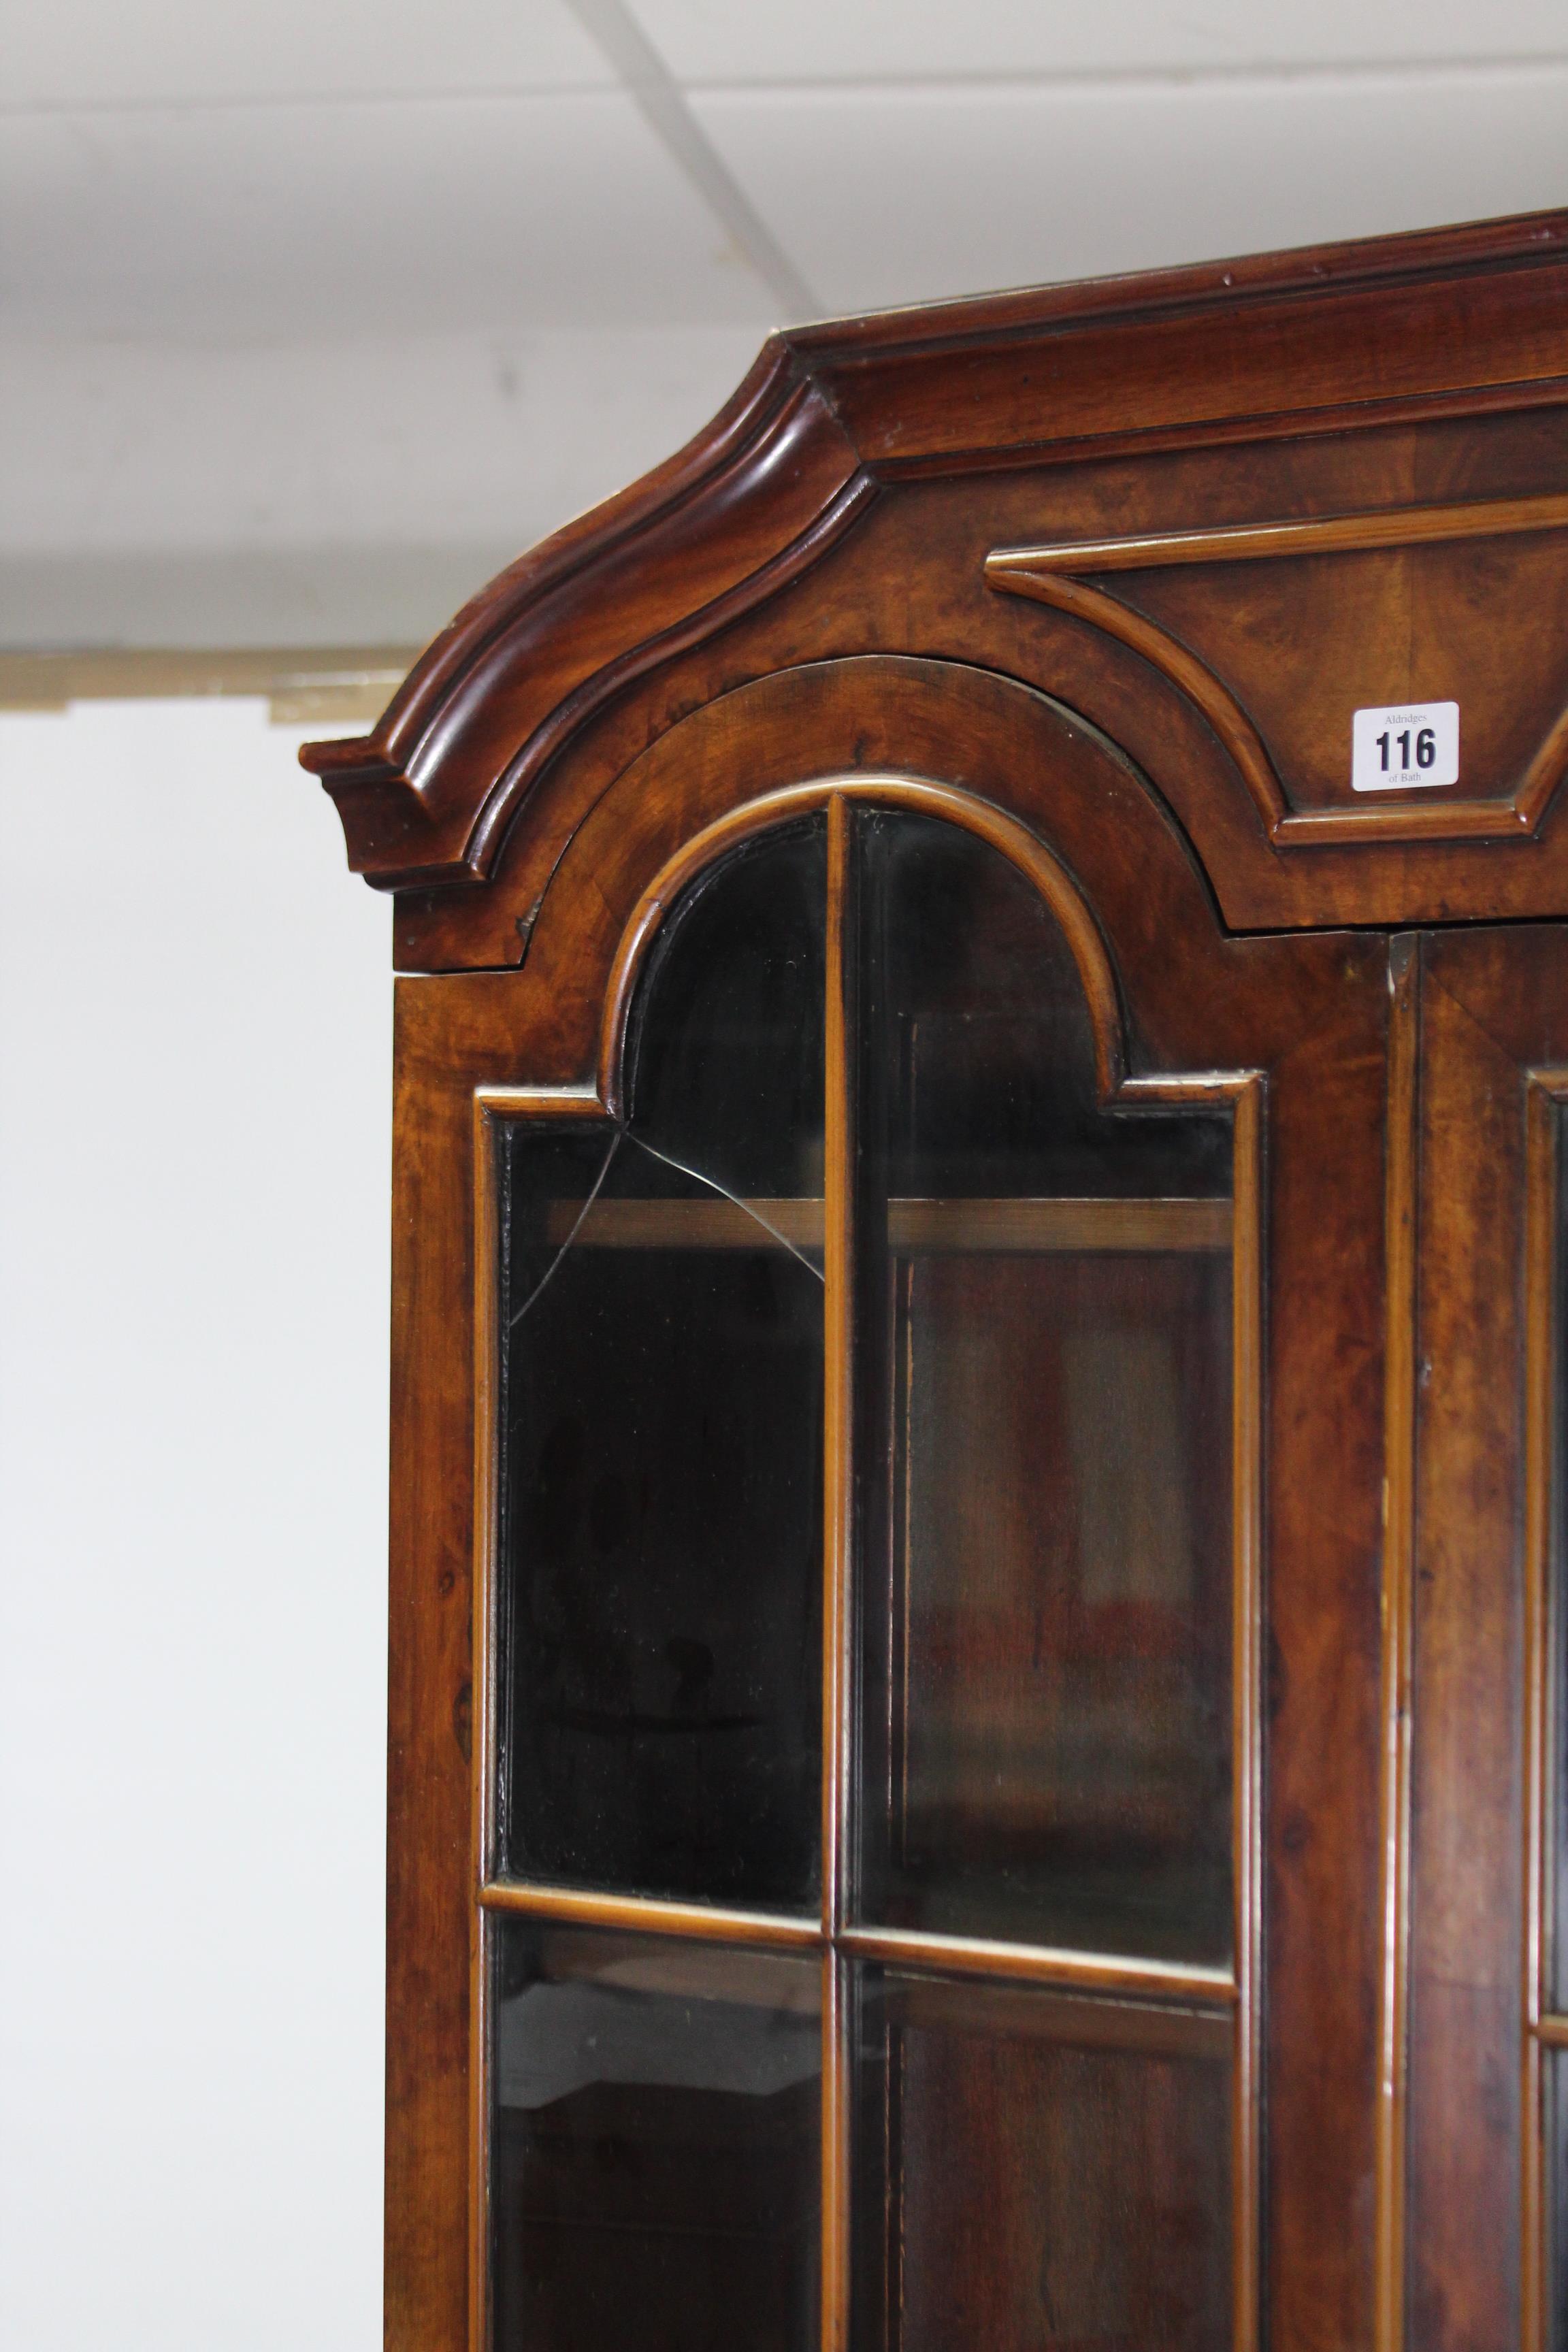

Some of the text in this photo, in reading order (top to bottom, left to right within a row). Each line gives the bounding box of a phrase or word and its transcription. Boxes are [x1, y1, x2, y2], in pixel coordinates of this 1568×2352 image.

[1385, 714, 1427, 725] Aldridges
[1376, 728, 1436, 772] 116
[1389, 772, 1422, 783] of Bath
